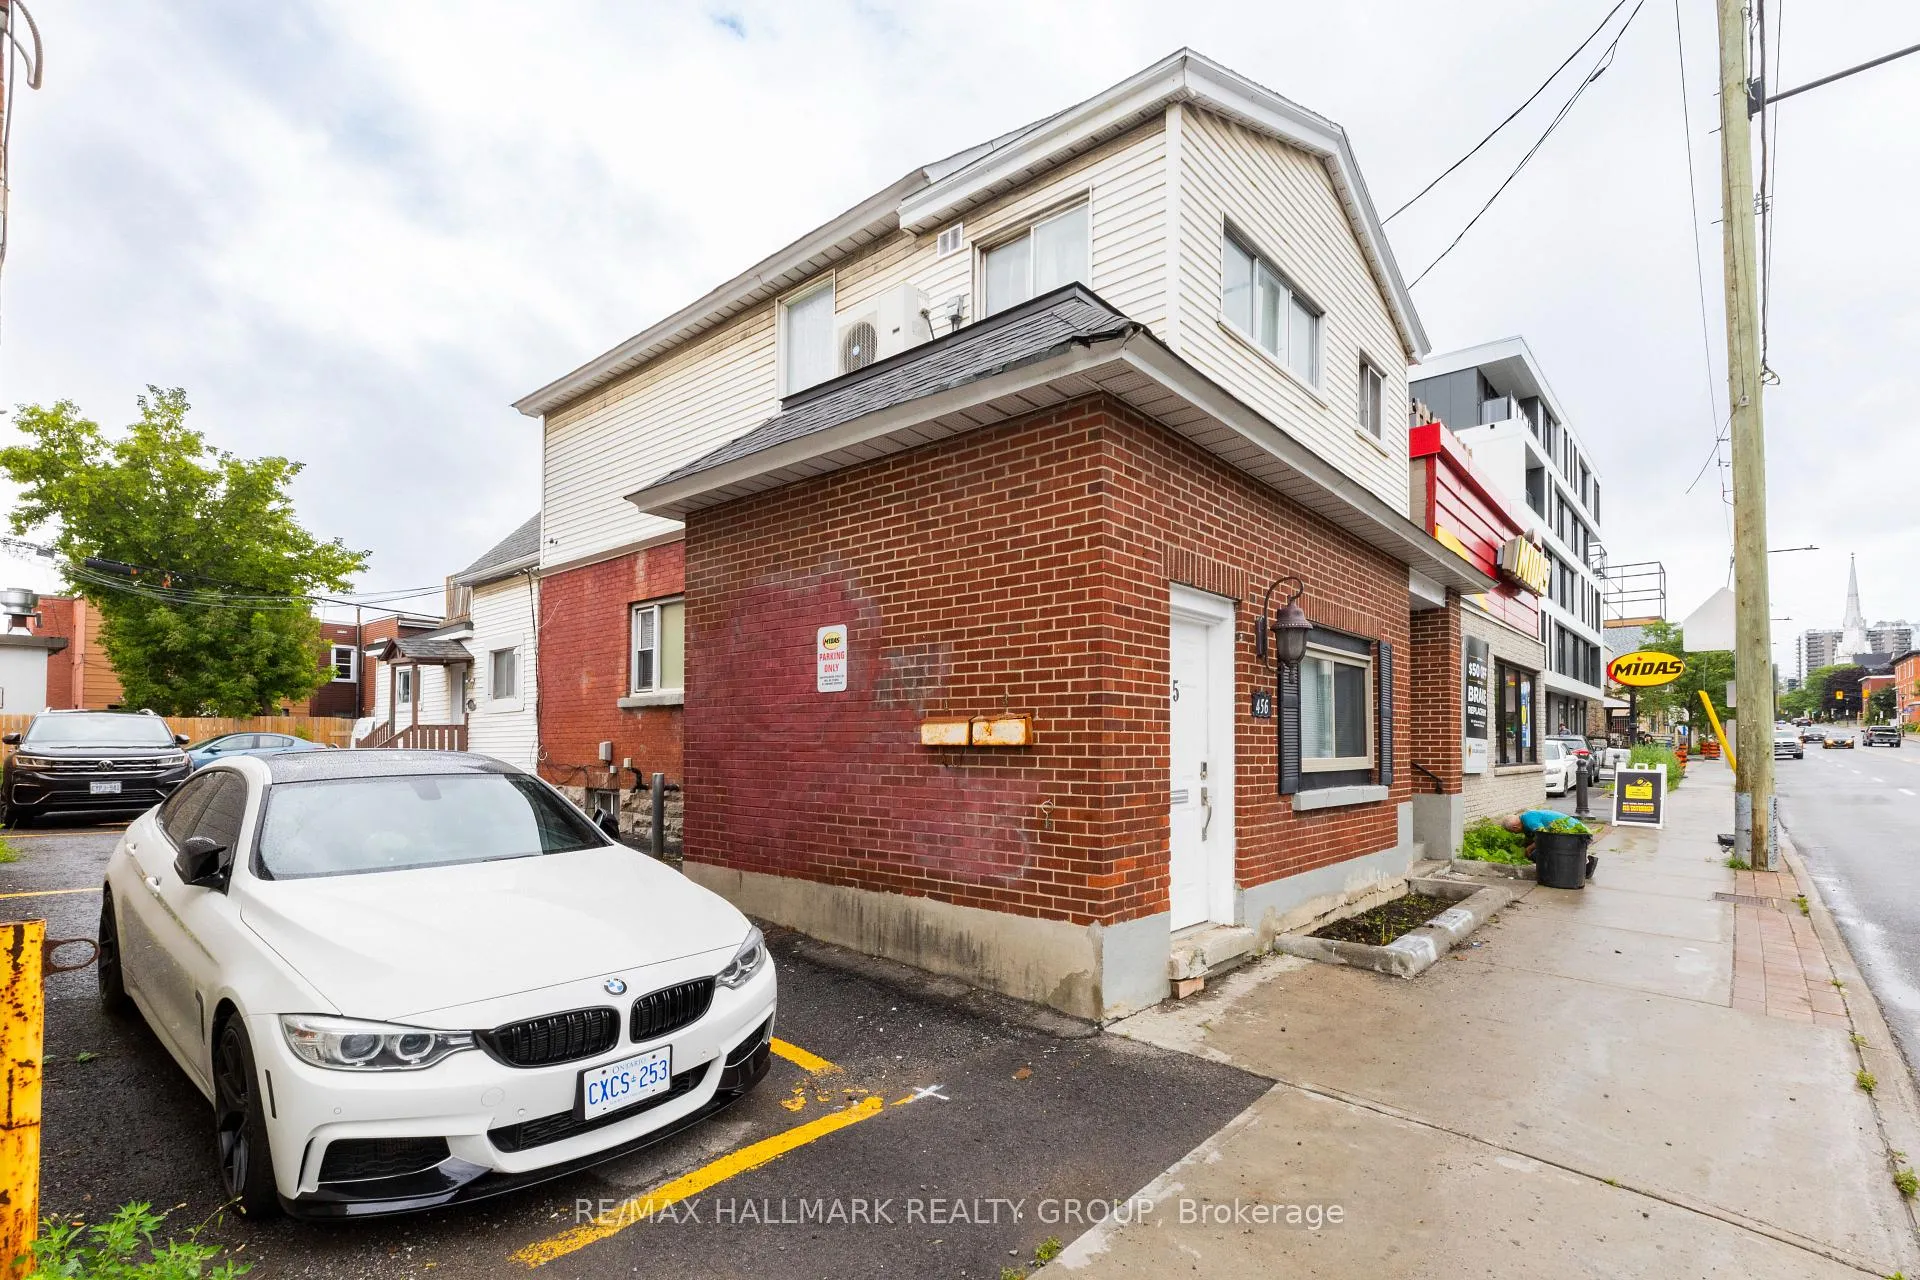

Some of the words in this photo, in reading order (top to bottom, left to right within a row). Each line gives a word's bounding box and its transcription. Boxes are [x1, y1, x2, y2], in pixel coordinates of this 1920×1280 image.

[1516, 536, 1551, 596] MIDAS
[819, 651, 845, 661] PARKING
[824, 664, 839, 673] ONLY
[1613, 661, 1682, 677] MIDAS
[1173, 680, 1179, 702] 5
[1256, 698, 1269, 714] 456
[612, 1058, 647, 1074] ONTARIO
